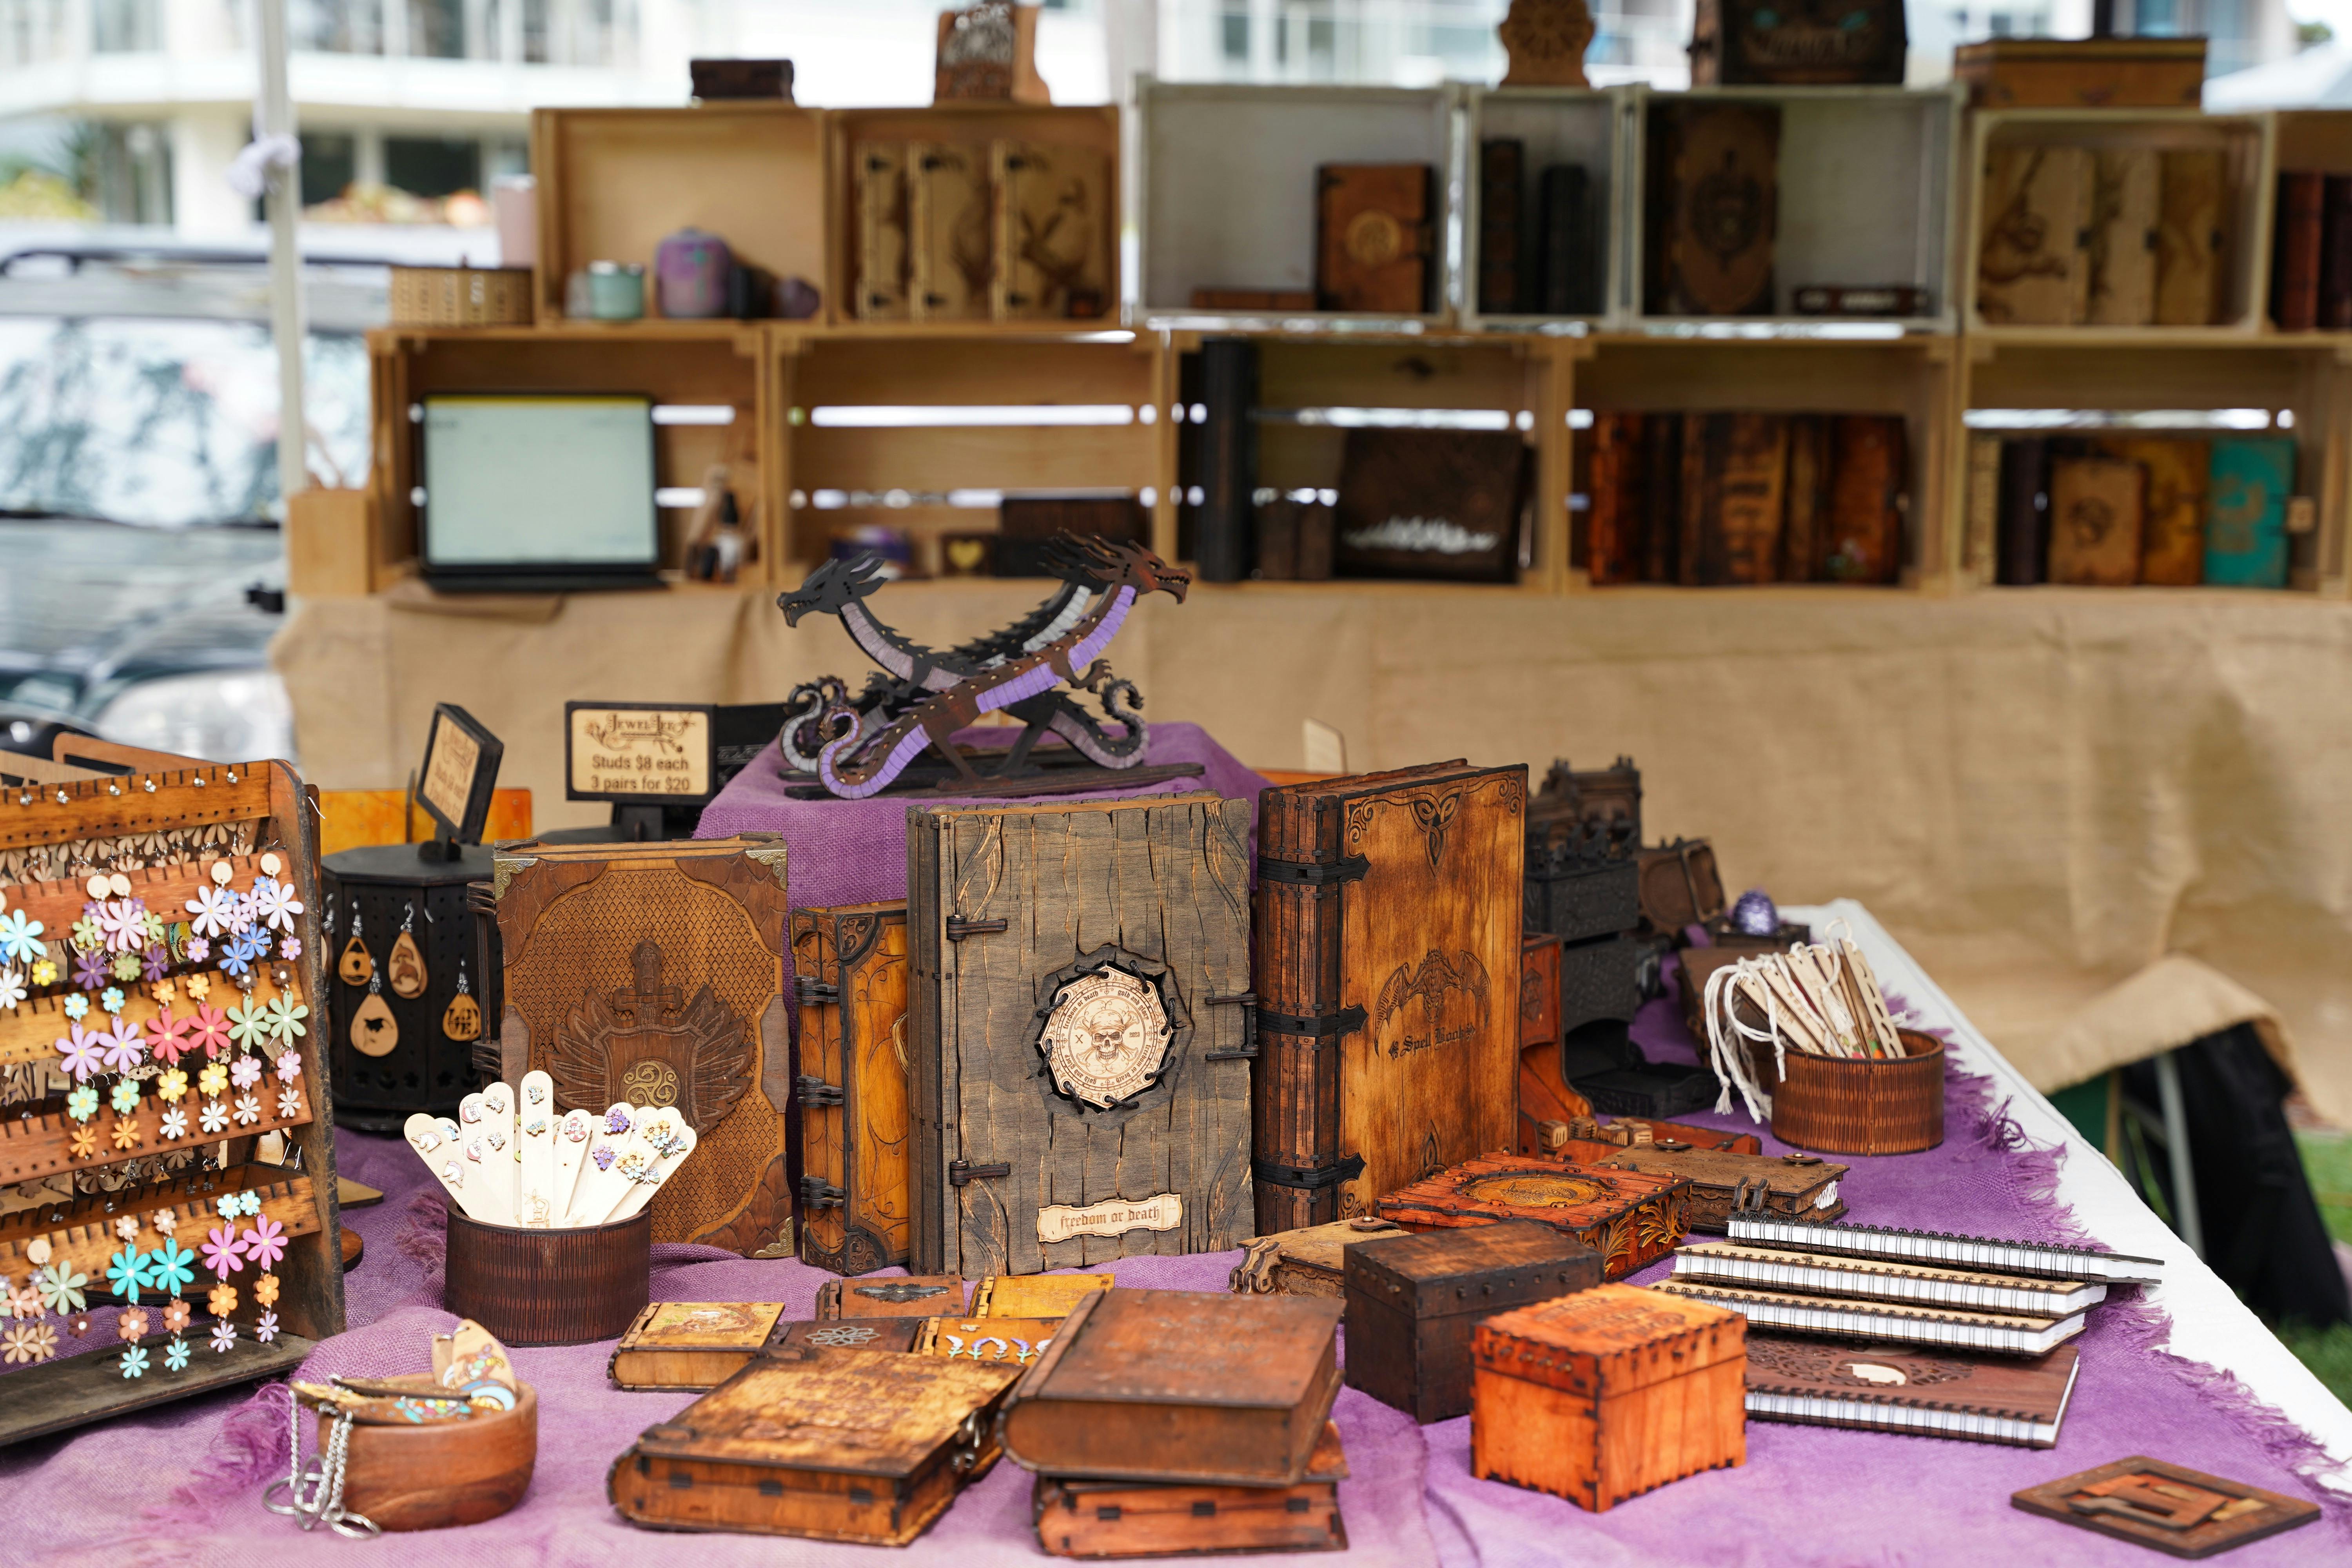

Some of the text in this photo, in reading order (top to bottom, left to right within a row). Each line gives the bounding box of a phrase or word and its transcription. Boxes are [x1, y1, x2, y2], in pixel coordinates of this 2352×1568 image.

[592, 754, 689, 771] Studs $8 each
[591, 775, 690, 793] 3 pairs for $20
[1063, 1006, 1078, 1029] freedom
[1083, 990, 1098, 1001] death
[1118, 990, 1149, 1020] gold and glory
[1400, 1024, 1465, 1057] Spell Book
[1116, 1072, 1131, 1083] death
[1060, 1206, 1160, 1230] freedom or death
